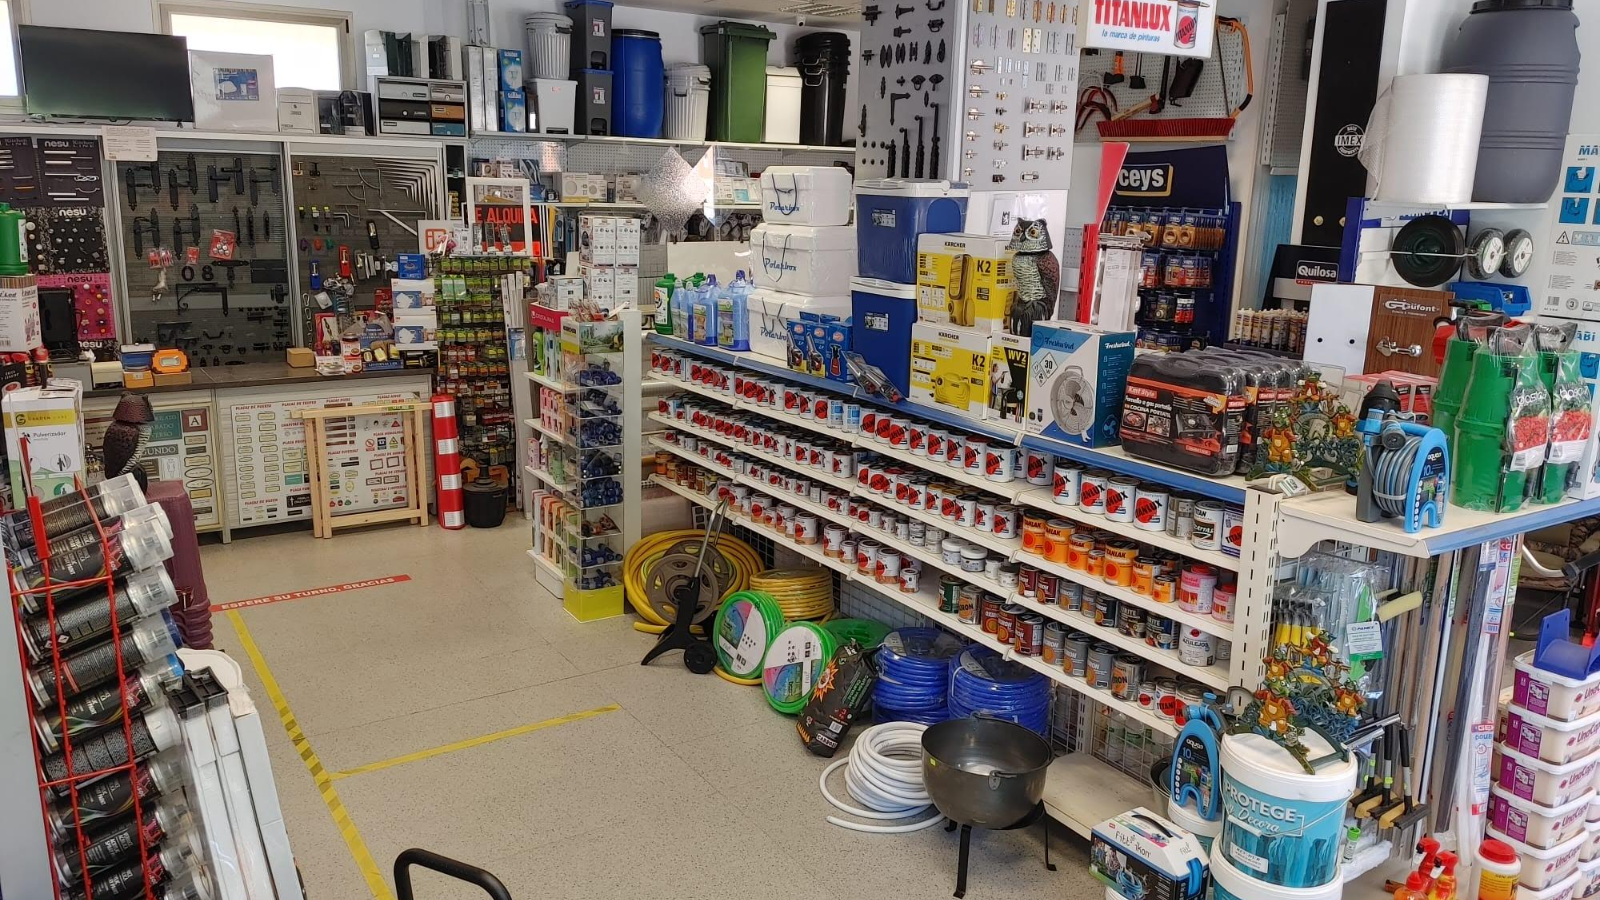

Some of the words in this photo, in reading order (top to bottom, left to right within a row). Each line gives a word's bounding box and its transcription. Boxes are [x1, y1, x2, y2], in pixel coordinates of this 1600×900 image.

[1095, 0, 1171, 31] TITANLUX
[1101, 29, 1107, 37] la
[1129, 30, 1136, 40] de
[1138, 34, 1160, 44] pinturas
[1337, 136, 1362, 145] IMEX
[1118, 168, 1154, 190] ceys
[765, 258, 797, 271] Polarbox
[1298, 266, 1337, 278] Quilosa
[1045, 359, 1053, 369] 30
[191, 417, 200, 425] A
[222, 597, 270, 609] ESPERE
[297, 588, 341, 597] TURNO,
[344, 578, 395, 589] GRACIAS
[1183, 639, 1210, 648] AZULEJOS
[1225, 782, 1297, 822] PROTEGE
[1238, 808, 1281, 833] Decora
